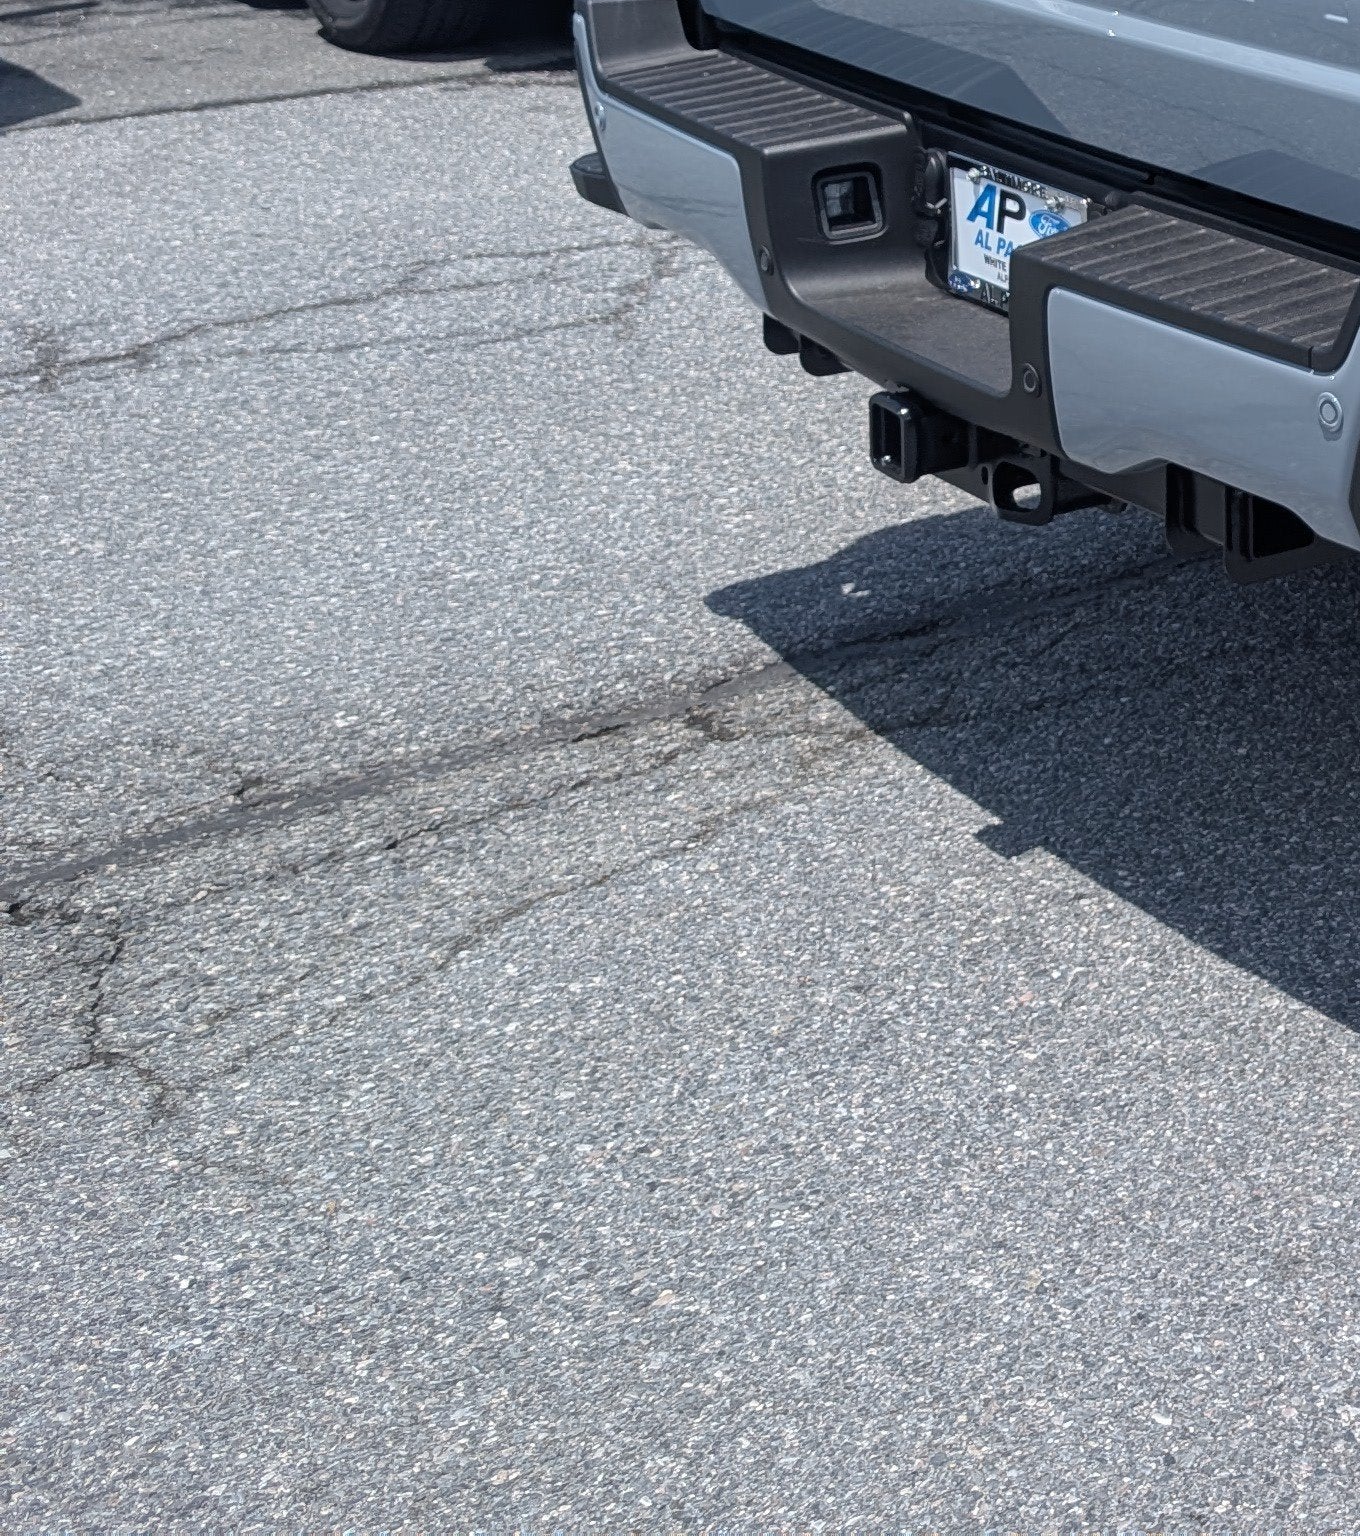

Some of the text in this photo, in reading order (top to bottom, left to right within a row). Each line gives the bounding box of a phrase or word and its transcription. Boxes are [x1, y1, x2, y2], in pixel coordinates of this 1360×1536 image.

[966, 183, 1026, 234] AP
[974, 229, 992, 252] AL
[984, 254, 1007, 272] WHITE
